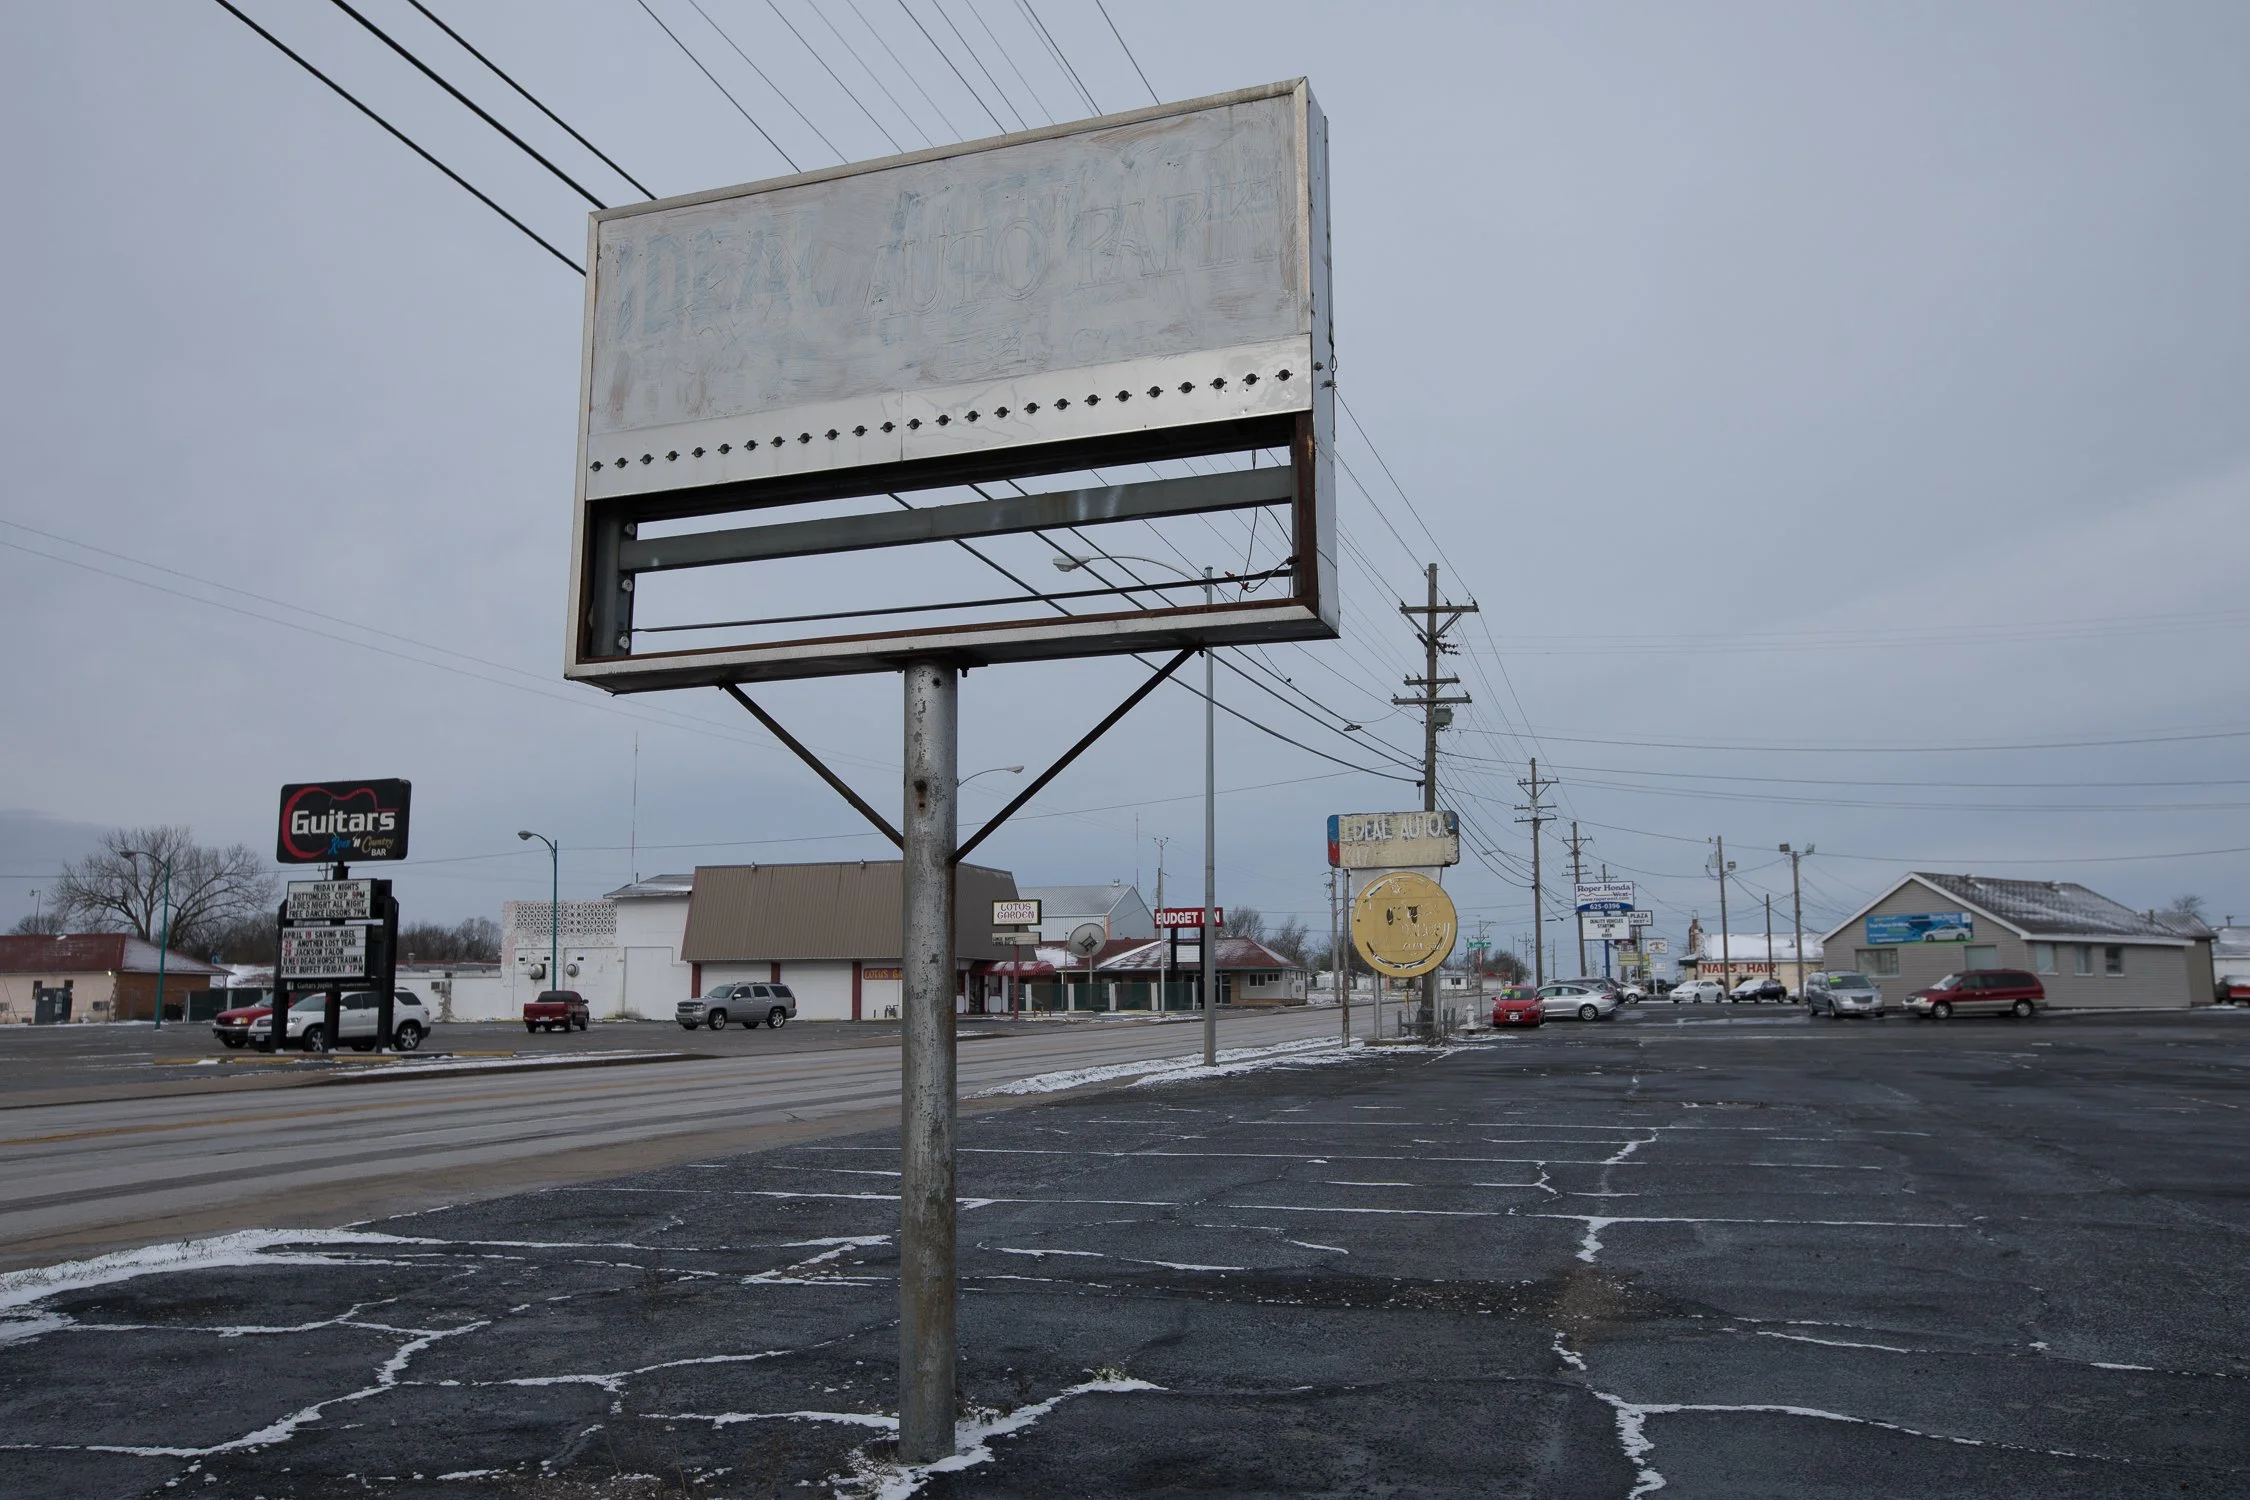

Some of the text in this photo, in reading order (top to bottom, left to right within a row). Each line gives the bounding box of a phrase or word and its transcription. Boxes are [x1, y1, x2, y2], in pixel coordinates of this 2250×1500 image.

[291, 809, 395, 835] Guitars
[313, 882, 359, 892] FRIDAY NIGHTS
[1577, 883, 1631, 893] Roper Honda
[293, 892, 330, 900] BOTTOMLESS
[334, 891, 348, 899] CUP
[289, 900, 364, 909] LADIES NIGHT ALL NIGHT
[1001, 903, 1031, 911] LOTUS
[289, 908, 366, 918] FREE DANCE LESSONS 7PM
[997, 911, 1034, 919] GARDEN
[1155, 911, 1220, 925] BUDGET IN
[284, 931, 302, 939] APRIL
[314, 930, 337, 938] SAVING
[340, 930, 356, 938] ABEL
[297, 939, 323, 947] ANOTHER
[325, 939, 339, 947] LOST
[294, 948, 322, 956] JACKSON
[324, 948, 344, 956] TALOR
[337, 956, 363, 964] TRAUMA
[282, 965, 297, 974] FREE
[299, 965, 321, 973] BUFFET
[322, 965, 346, 973] FRIDAY
[1702, 963, 1777, 978] NAIS HAIR
